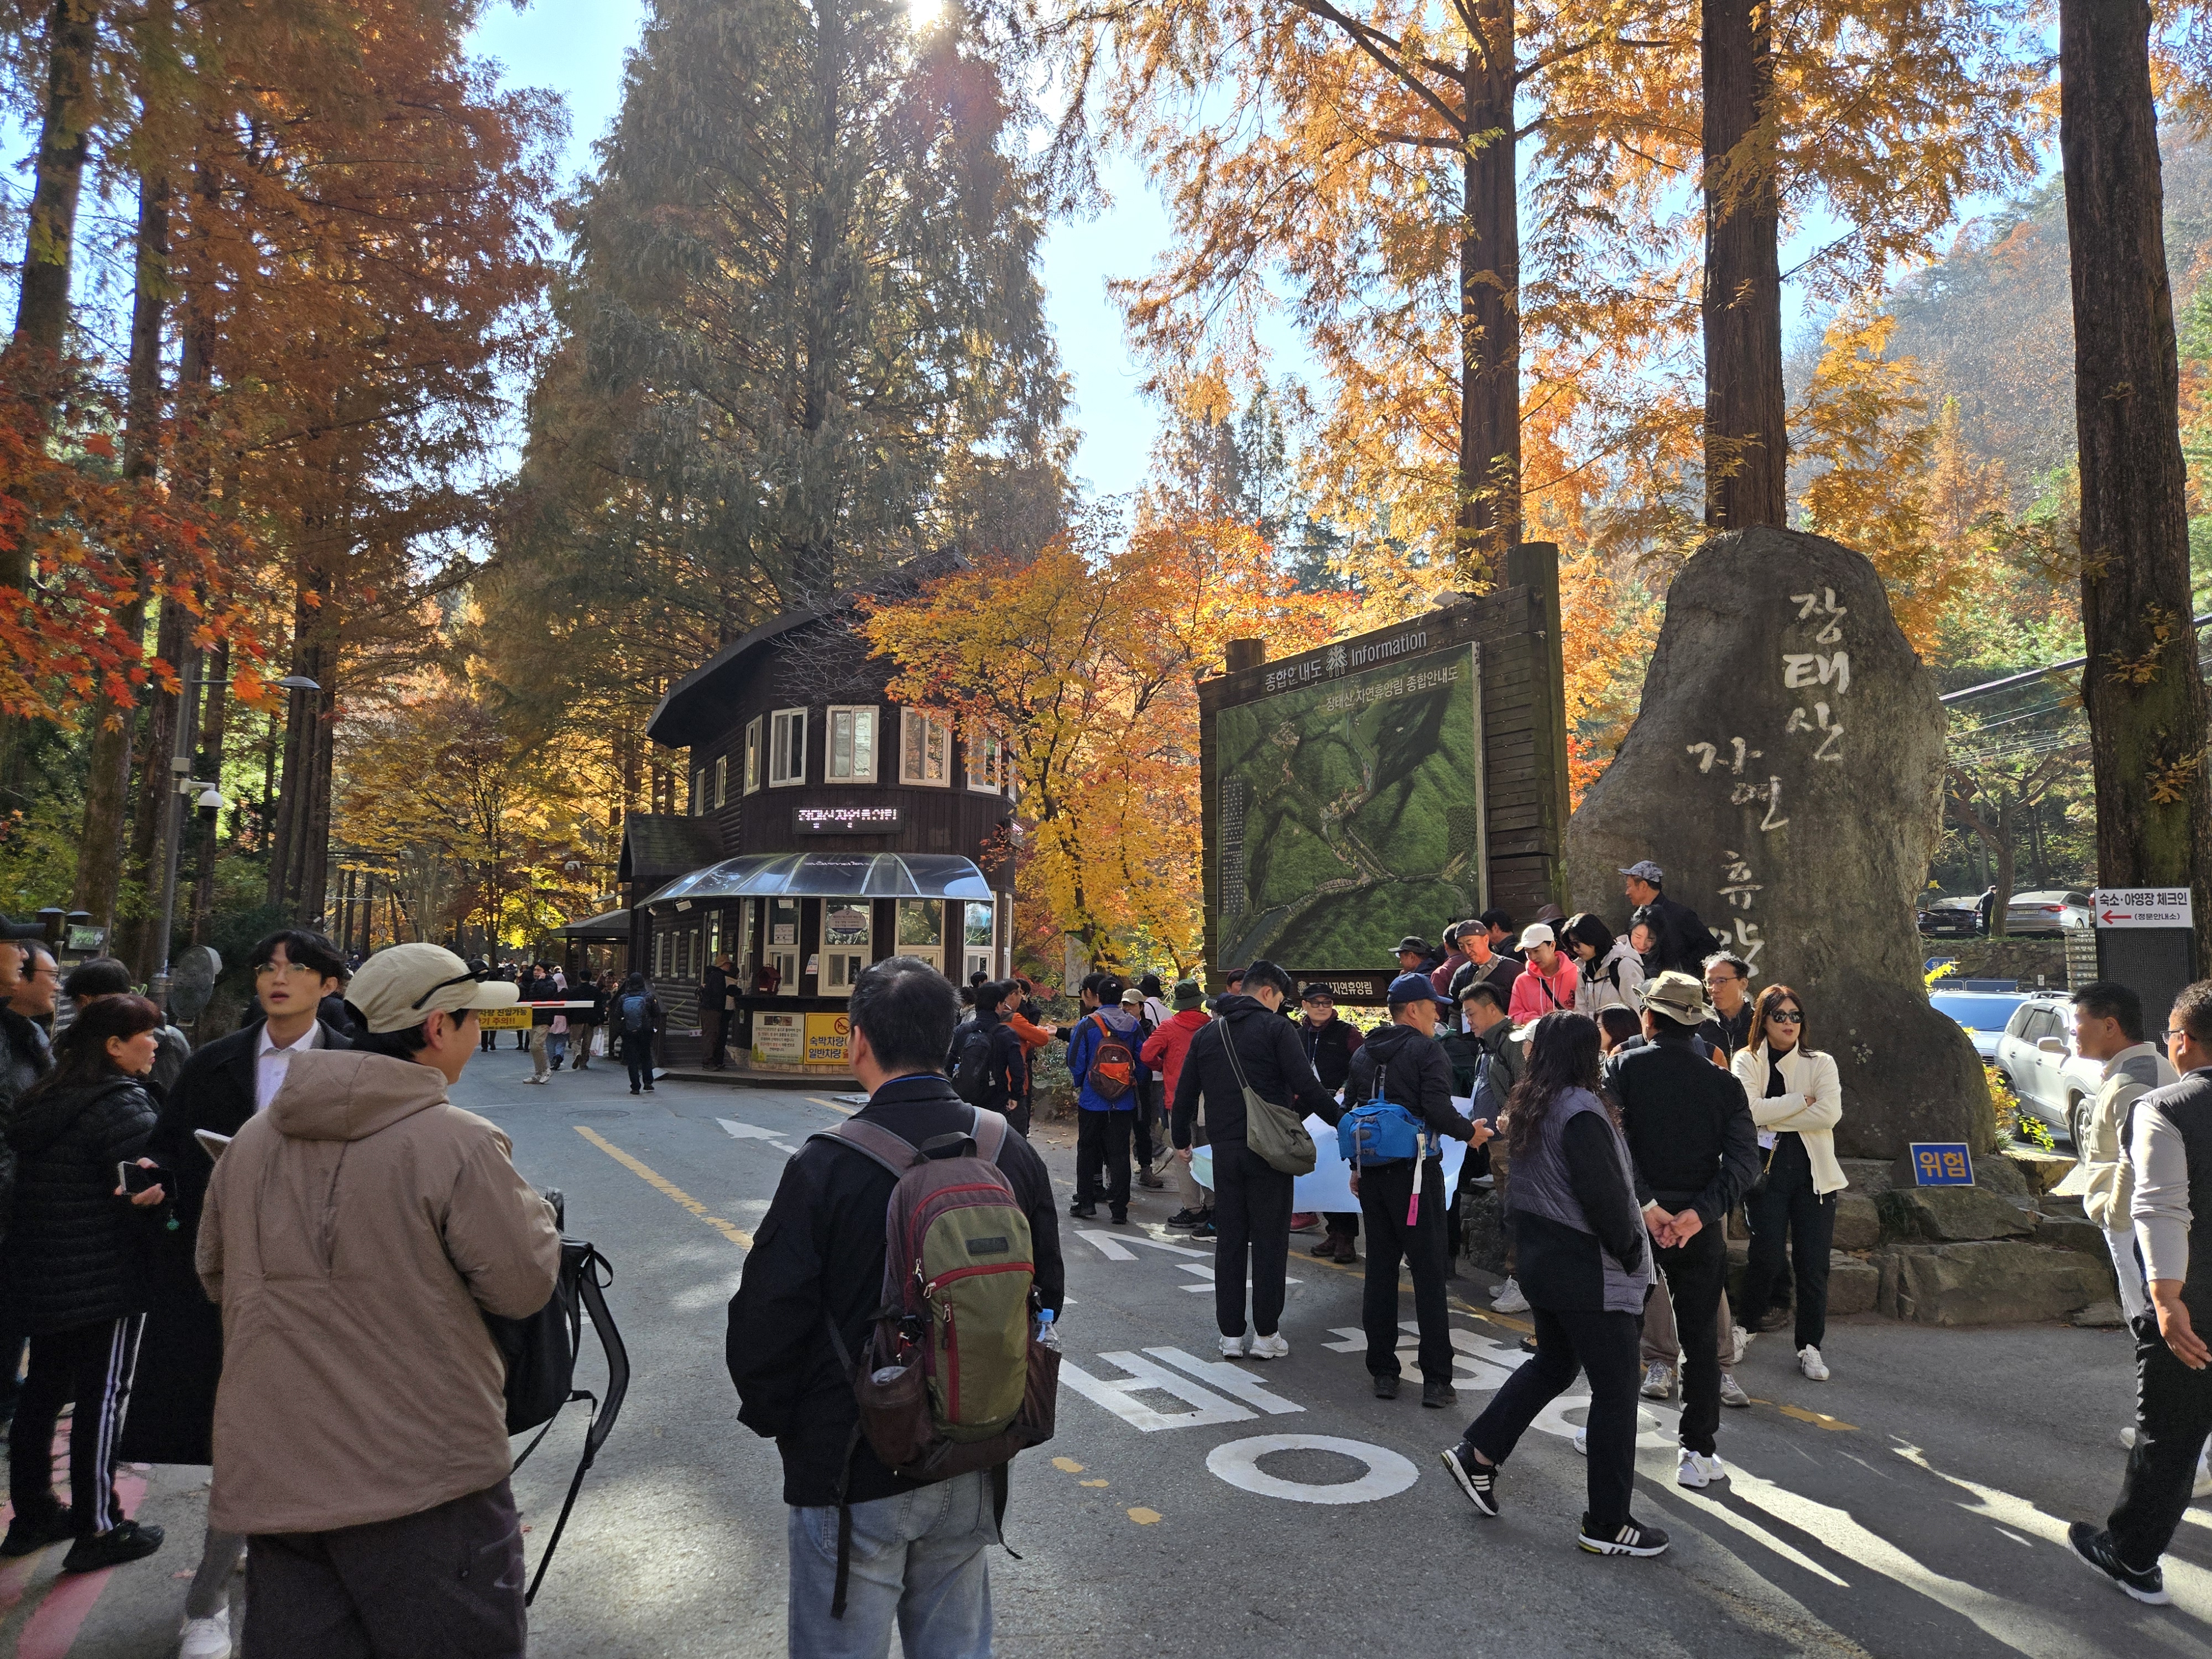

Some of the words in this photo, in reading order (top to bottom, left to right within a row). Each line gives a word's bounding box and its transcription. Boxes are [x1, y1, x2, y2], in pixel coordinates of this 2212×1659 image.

[1351, 632, 1427, 666] Information
[1783, 586, 1850, 763] 장태산
[1355, 683, 1403, 705] 자연휴양림
[1406, 666, 1459, 691] 종합안내도
[2157, 892, 2188, 905] 체크인
[2134, 912, 2180, 922] (정문안내소)
[493, 1017, 515, 1025] 주의!!
[809, 1048, 841, 1059] 일반차량
[1920, 1151, 1966, 1177] 위험
